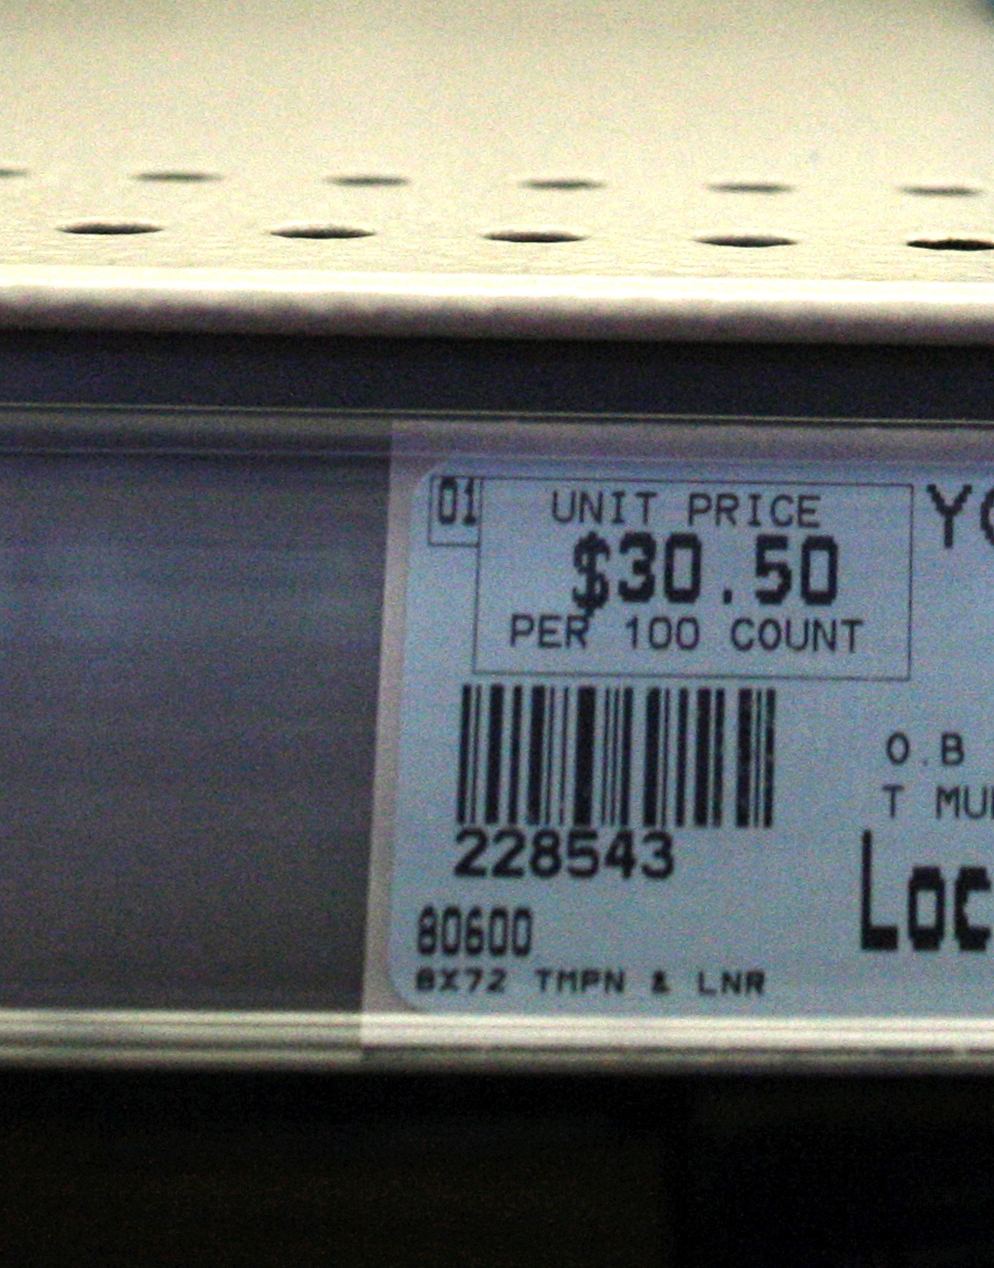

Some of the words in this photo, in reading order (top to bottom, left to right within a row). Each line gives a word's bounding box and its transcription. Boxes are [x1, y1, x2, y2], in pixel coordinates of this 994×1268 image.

[437, 475, 479, 525] 01
[551, 490, 658, 524] UNIT
[687, 493, 823, 527] PRICE
[572, 532, 840, 618] $30.50
[509, 614, 592, 649] PER
[624, 617, 700, 651] 100
[730, 619, 864, 653] COUNT
[882, 786, 906, 819] T
[453, 828, 676, 880] 228543
[416, 907, 534, 957] 80600
[699, 970, 766, 996] LNR
